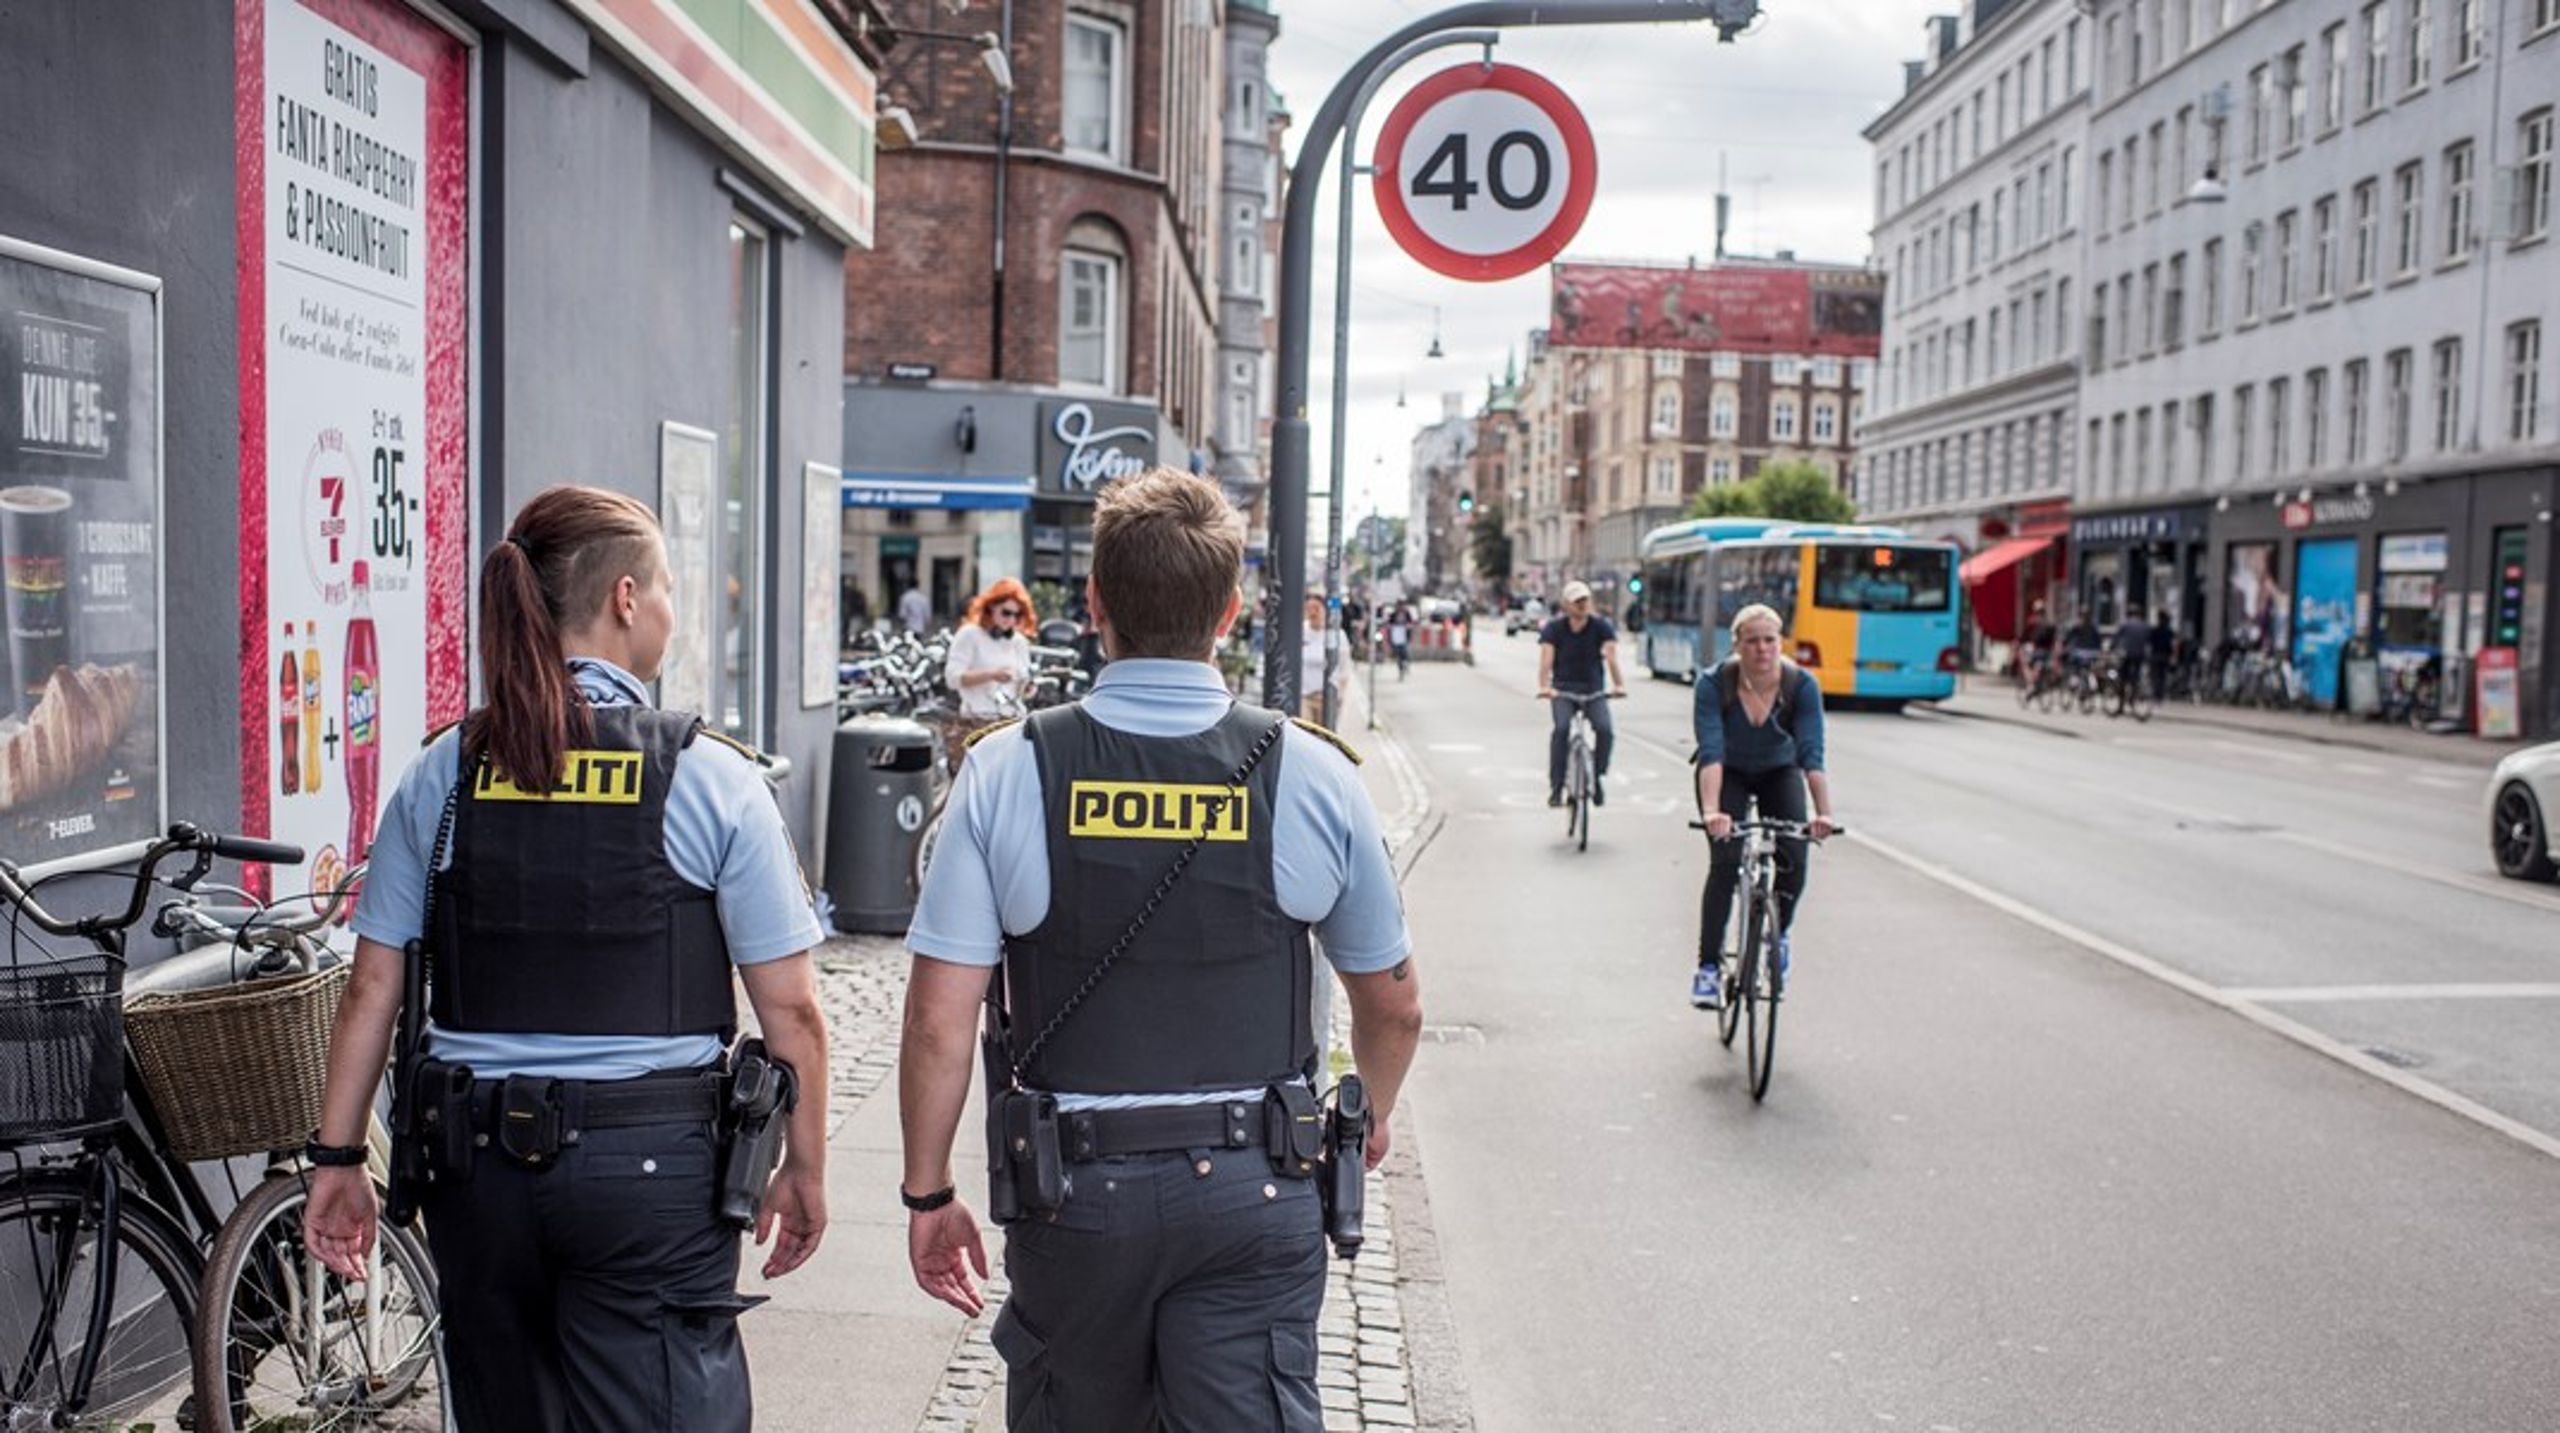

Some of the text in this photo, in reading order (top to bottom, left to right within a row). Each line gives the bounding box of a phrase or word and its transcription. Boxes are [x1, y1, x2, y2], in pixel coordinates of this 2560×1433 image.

[324, 37, 378, 118] GRATIS
[277, 94, 417, 211] FANTA RASPBERRY
[1411, 130, 1552, 211] 40
[286, 181, 409, 281] & PASSIONFRUIT
[22, 325, 68, 369] DENNE
[22, 371, 69, 445] KUN
[1073, 789, 1243, 832] POLITI
